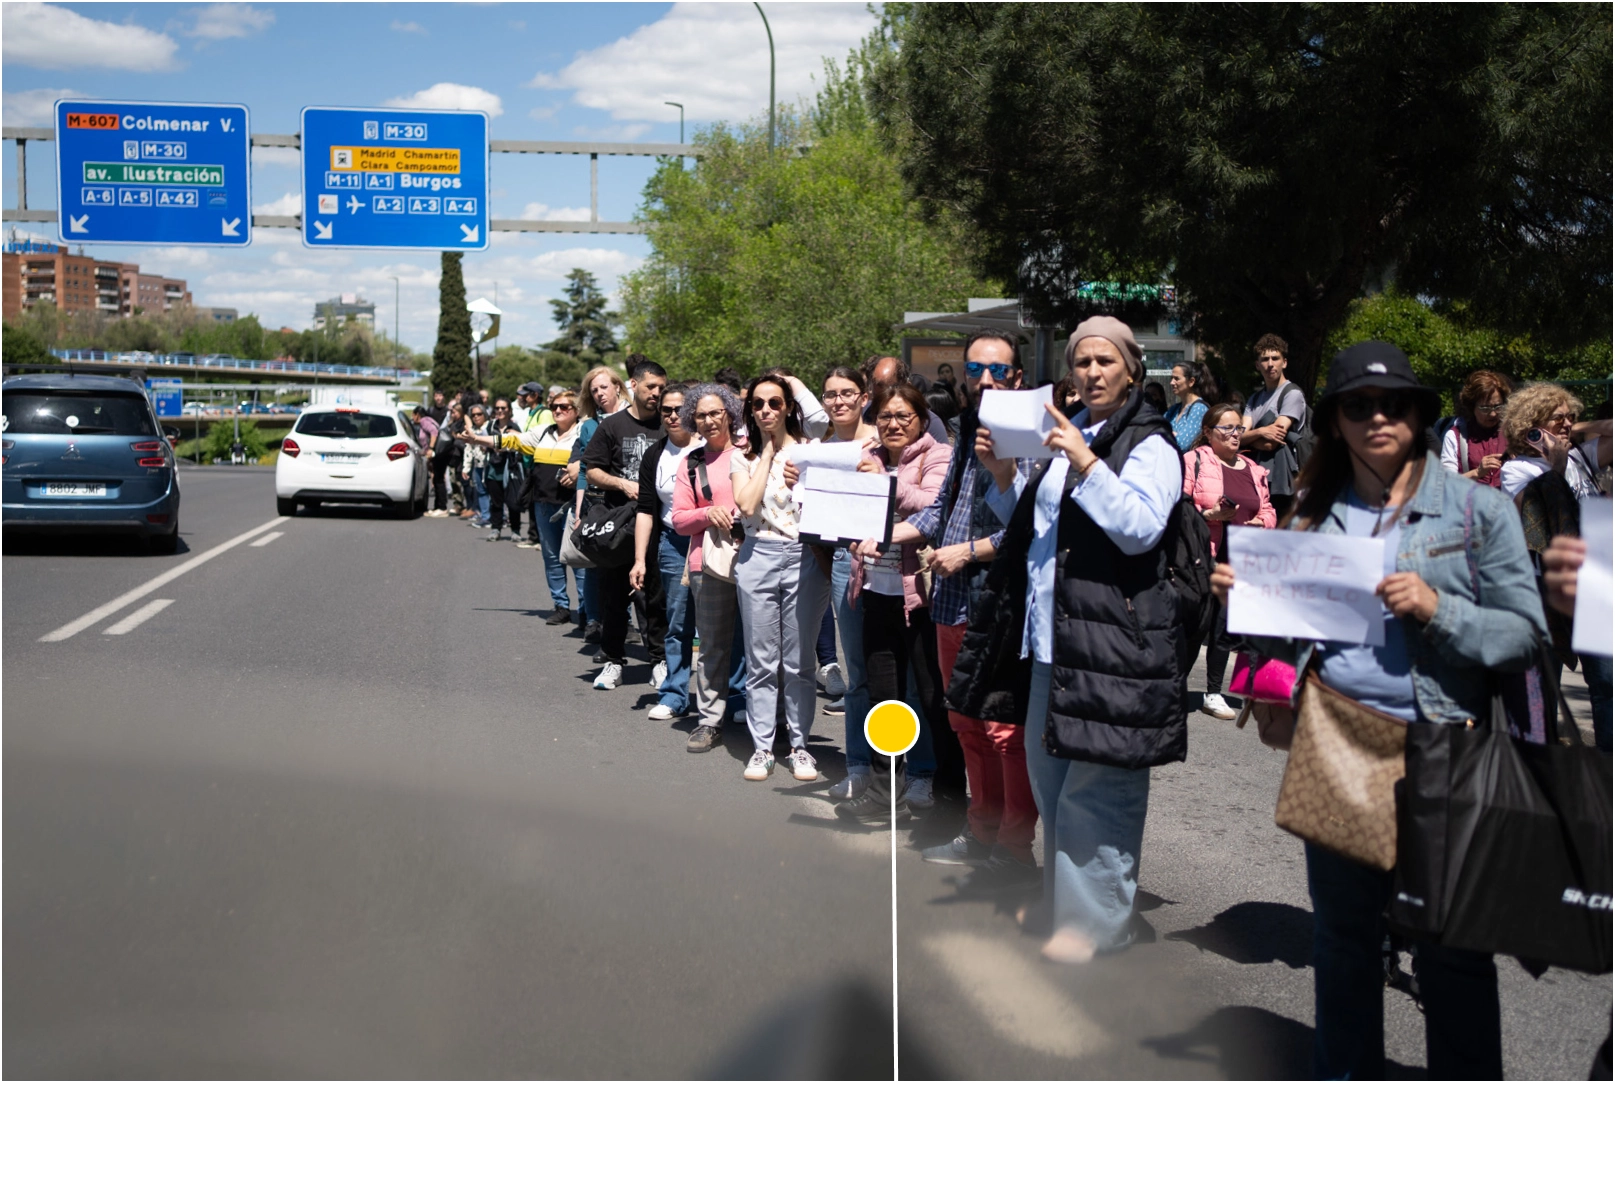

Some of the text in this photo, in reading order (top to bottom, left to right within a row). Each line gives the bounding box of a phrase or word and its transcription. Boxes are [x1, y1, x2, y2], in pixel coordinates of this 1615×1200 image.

[68, 115, 235, 132] M-607 Colmenar V.
[386, 125, 425, 138] M-30
[144, 143, 184, 157] M-30
[360, 149, 396, 158] Madrid
[360, 160, 458, 172] Clara Campoamor
[86, 165, 221, 183] av. Ilustración
[328, 173, 462, 191] M-11 A-1 Burgos
[85, 190, 111, 203] A-6
[122, 191, 149, 204] A-5
[159, 192, 195, 205] A-42
[376, 198, 474, 213] A-2 A-3 A-4
[49, 483, 102, 495] 8802 JMF
